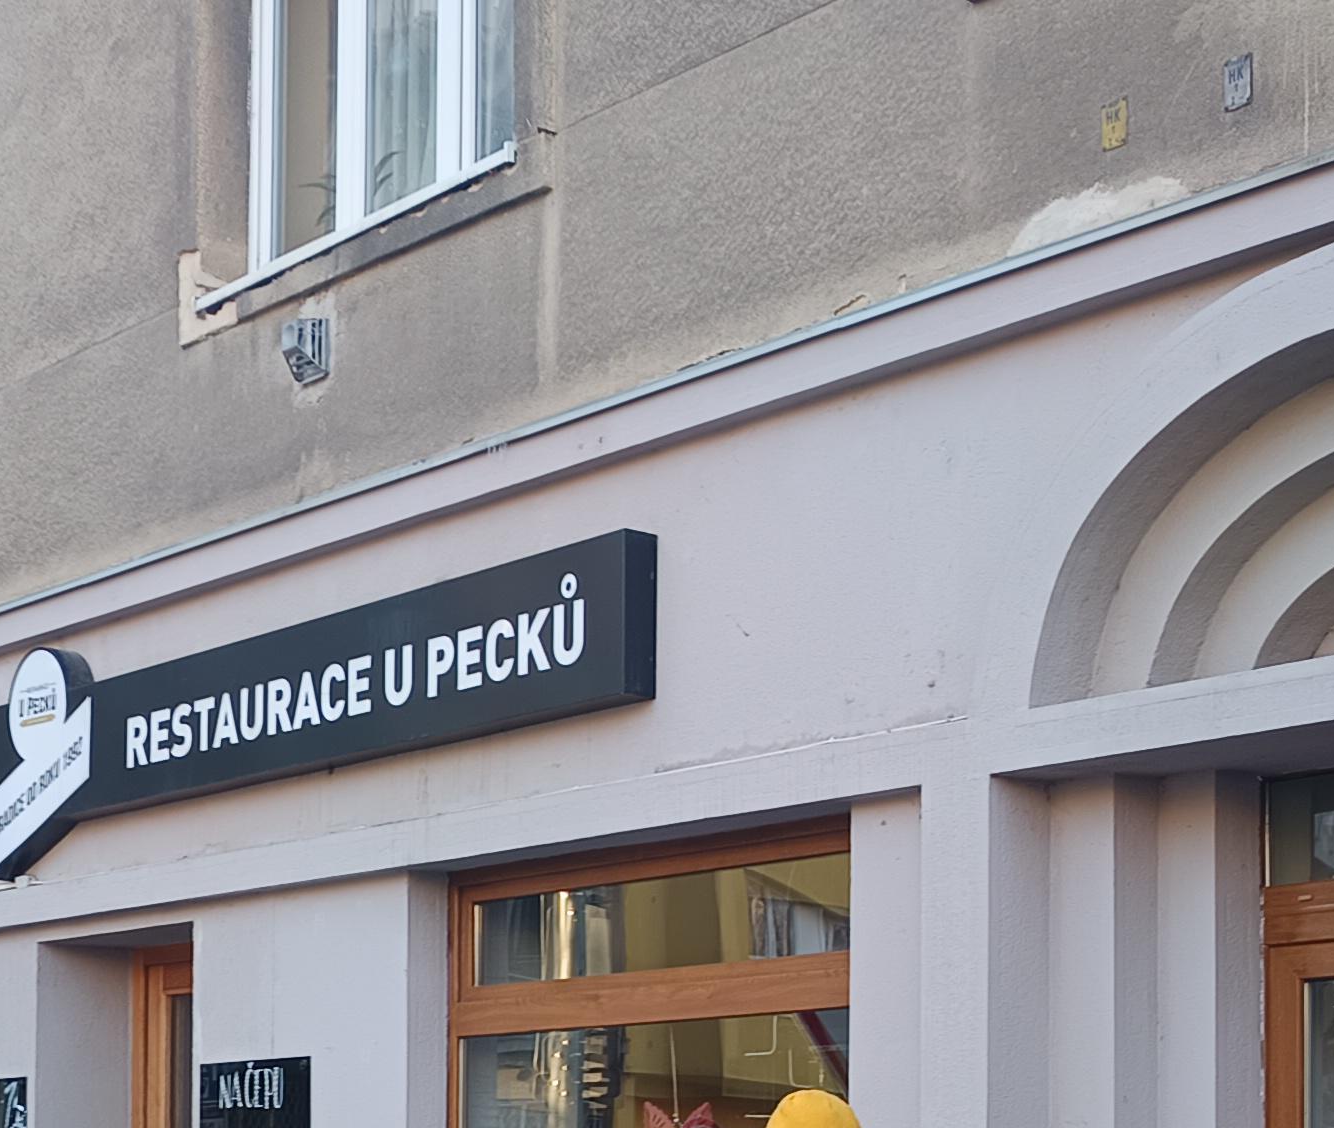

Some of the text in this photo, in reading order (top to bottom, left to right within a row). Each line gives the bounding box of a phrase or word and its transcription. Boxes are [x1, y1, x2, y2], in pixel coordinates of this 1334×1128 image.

[124, 572, 586, 769] RESTAURACE U PECKŮ
[218, 1062, 284, 1110] NA ČEPU
